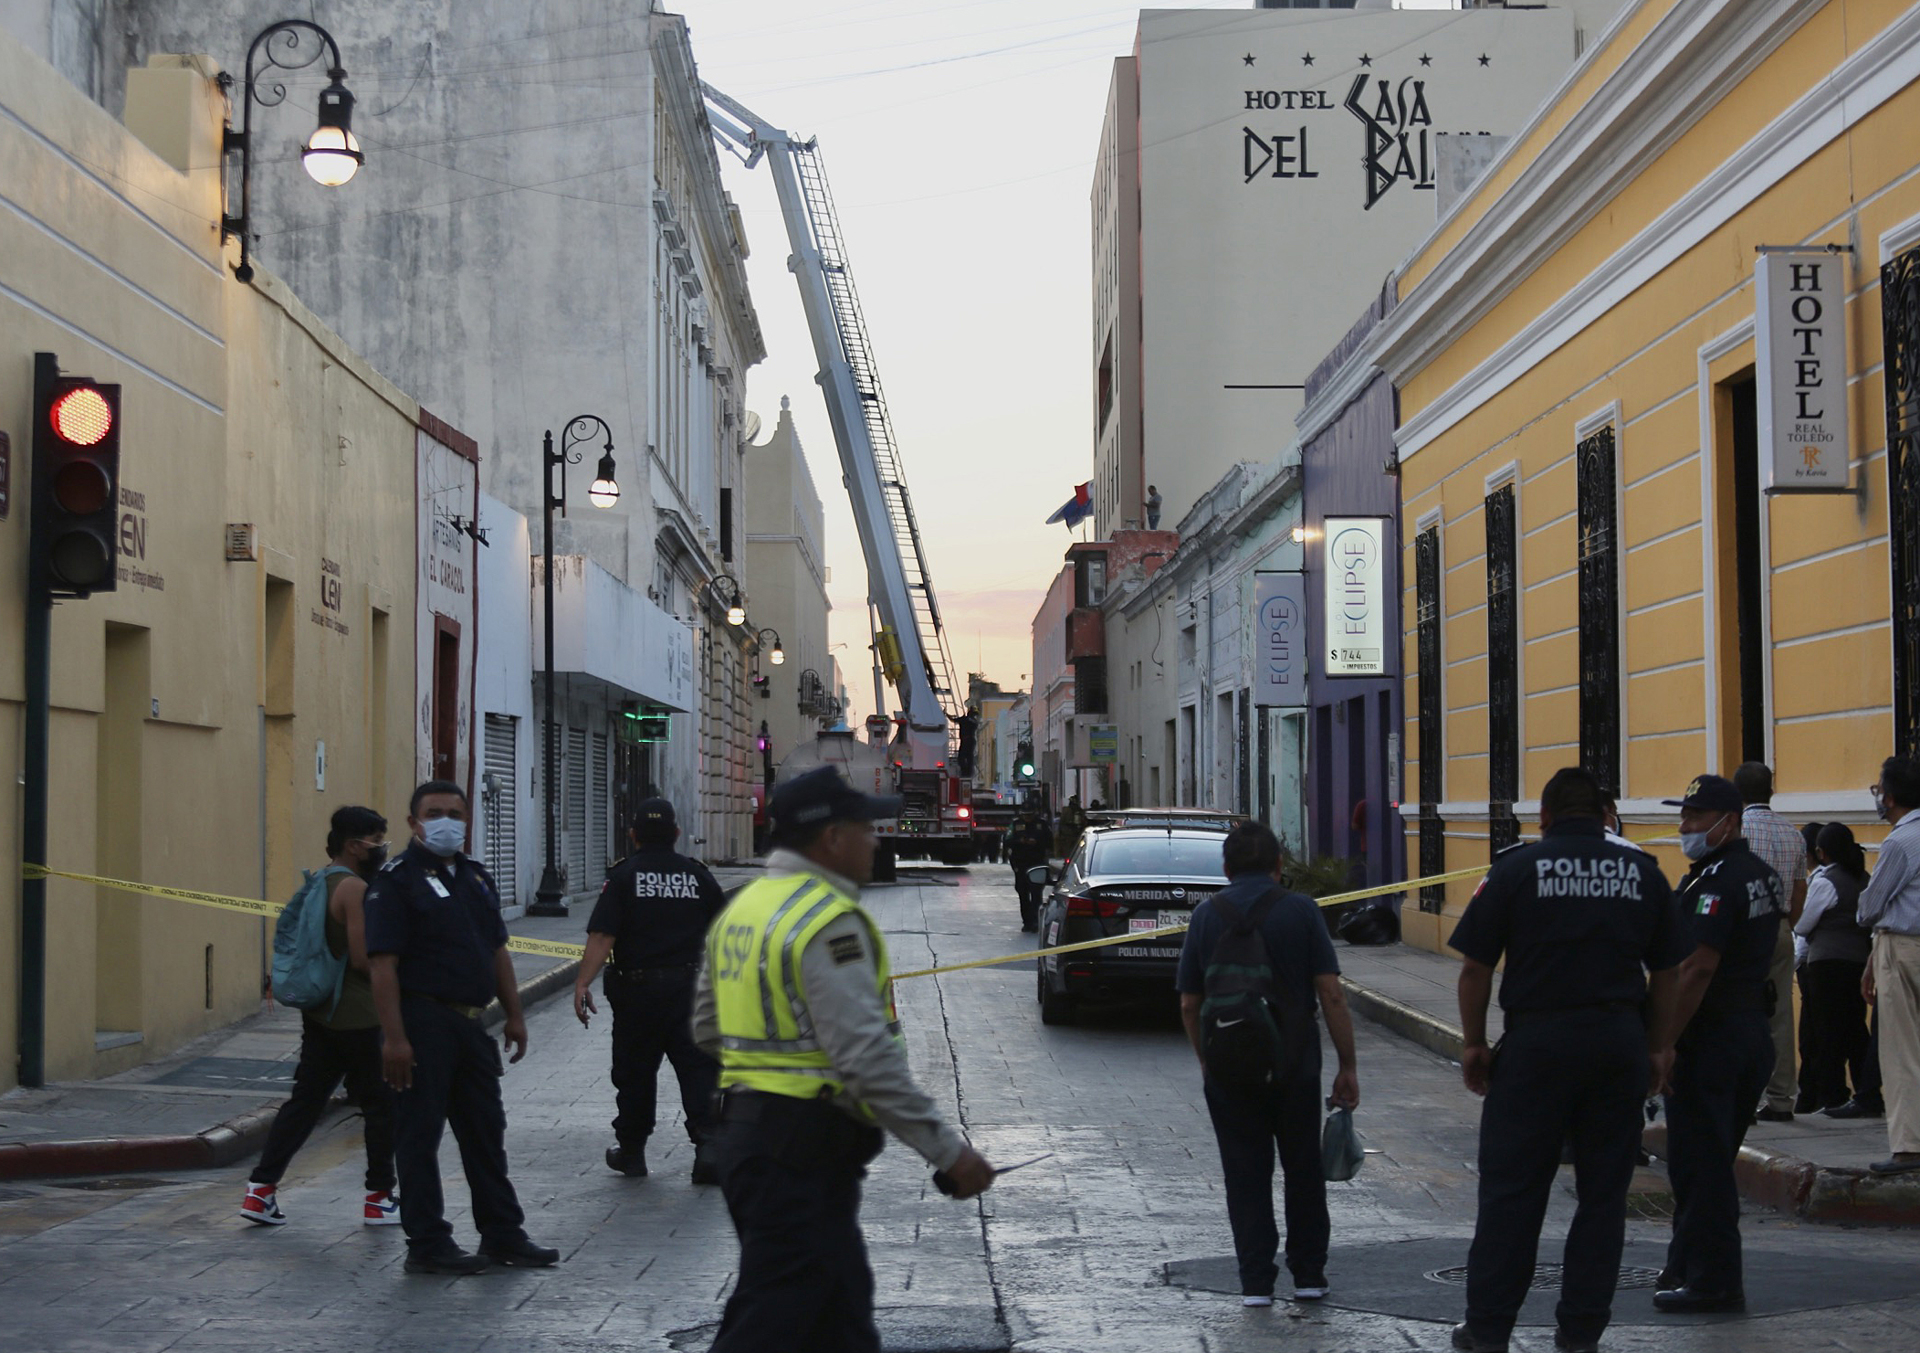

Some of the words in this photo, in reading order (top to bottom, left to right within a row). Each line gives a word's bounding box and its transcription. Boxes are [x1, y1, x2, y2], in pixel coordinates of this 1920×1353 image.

[1244, 90, 1335, 110] HOTEL
[1343, 74, 1432, 137] CASA
[1242, 125, 1319, 184] DEL
[1361, 126, 1491, 210] BAL
[1789, 264, 1824, 420] HOTEL
[1787, 433, 1834, 442] TOLEDO
[1795, 424, 1825, 433] REAL
[1795, 469, 1804, 478] by
[430, 554, 437, 582] EL
[1343, 542, 1369, 635] ECLIPSE
[1270, 607, 1292, 685] ECLIPSE
[1331, 649, 1338, 661] $
[1342, 650, 1362, 660] 744
[1536, 857, 1641, 881] POLICÍA
[636, 871, 699, 887] POLICÍA
[1537, 877, 1642, 900] MUNICIPAL
[636, 885, 700, 899] ESTATAL
[1125, 890, 1171, 900] MERIDA
[1118, 947, 1149, 957] POLICIA
